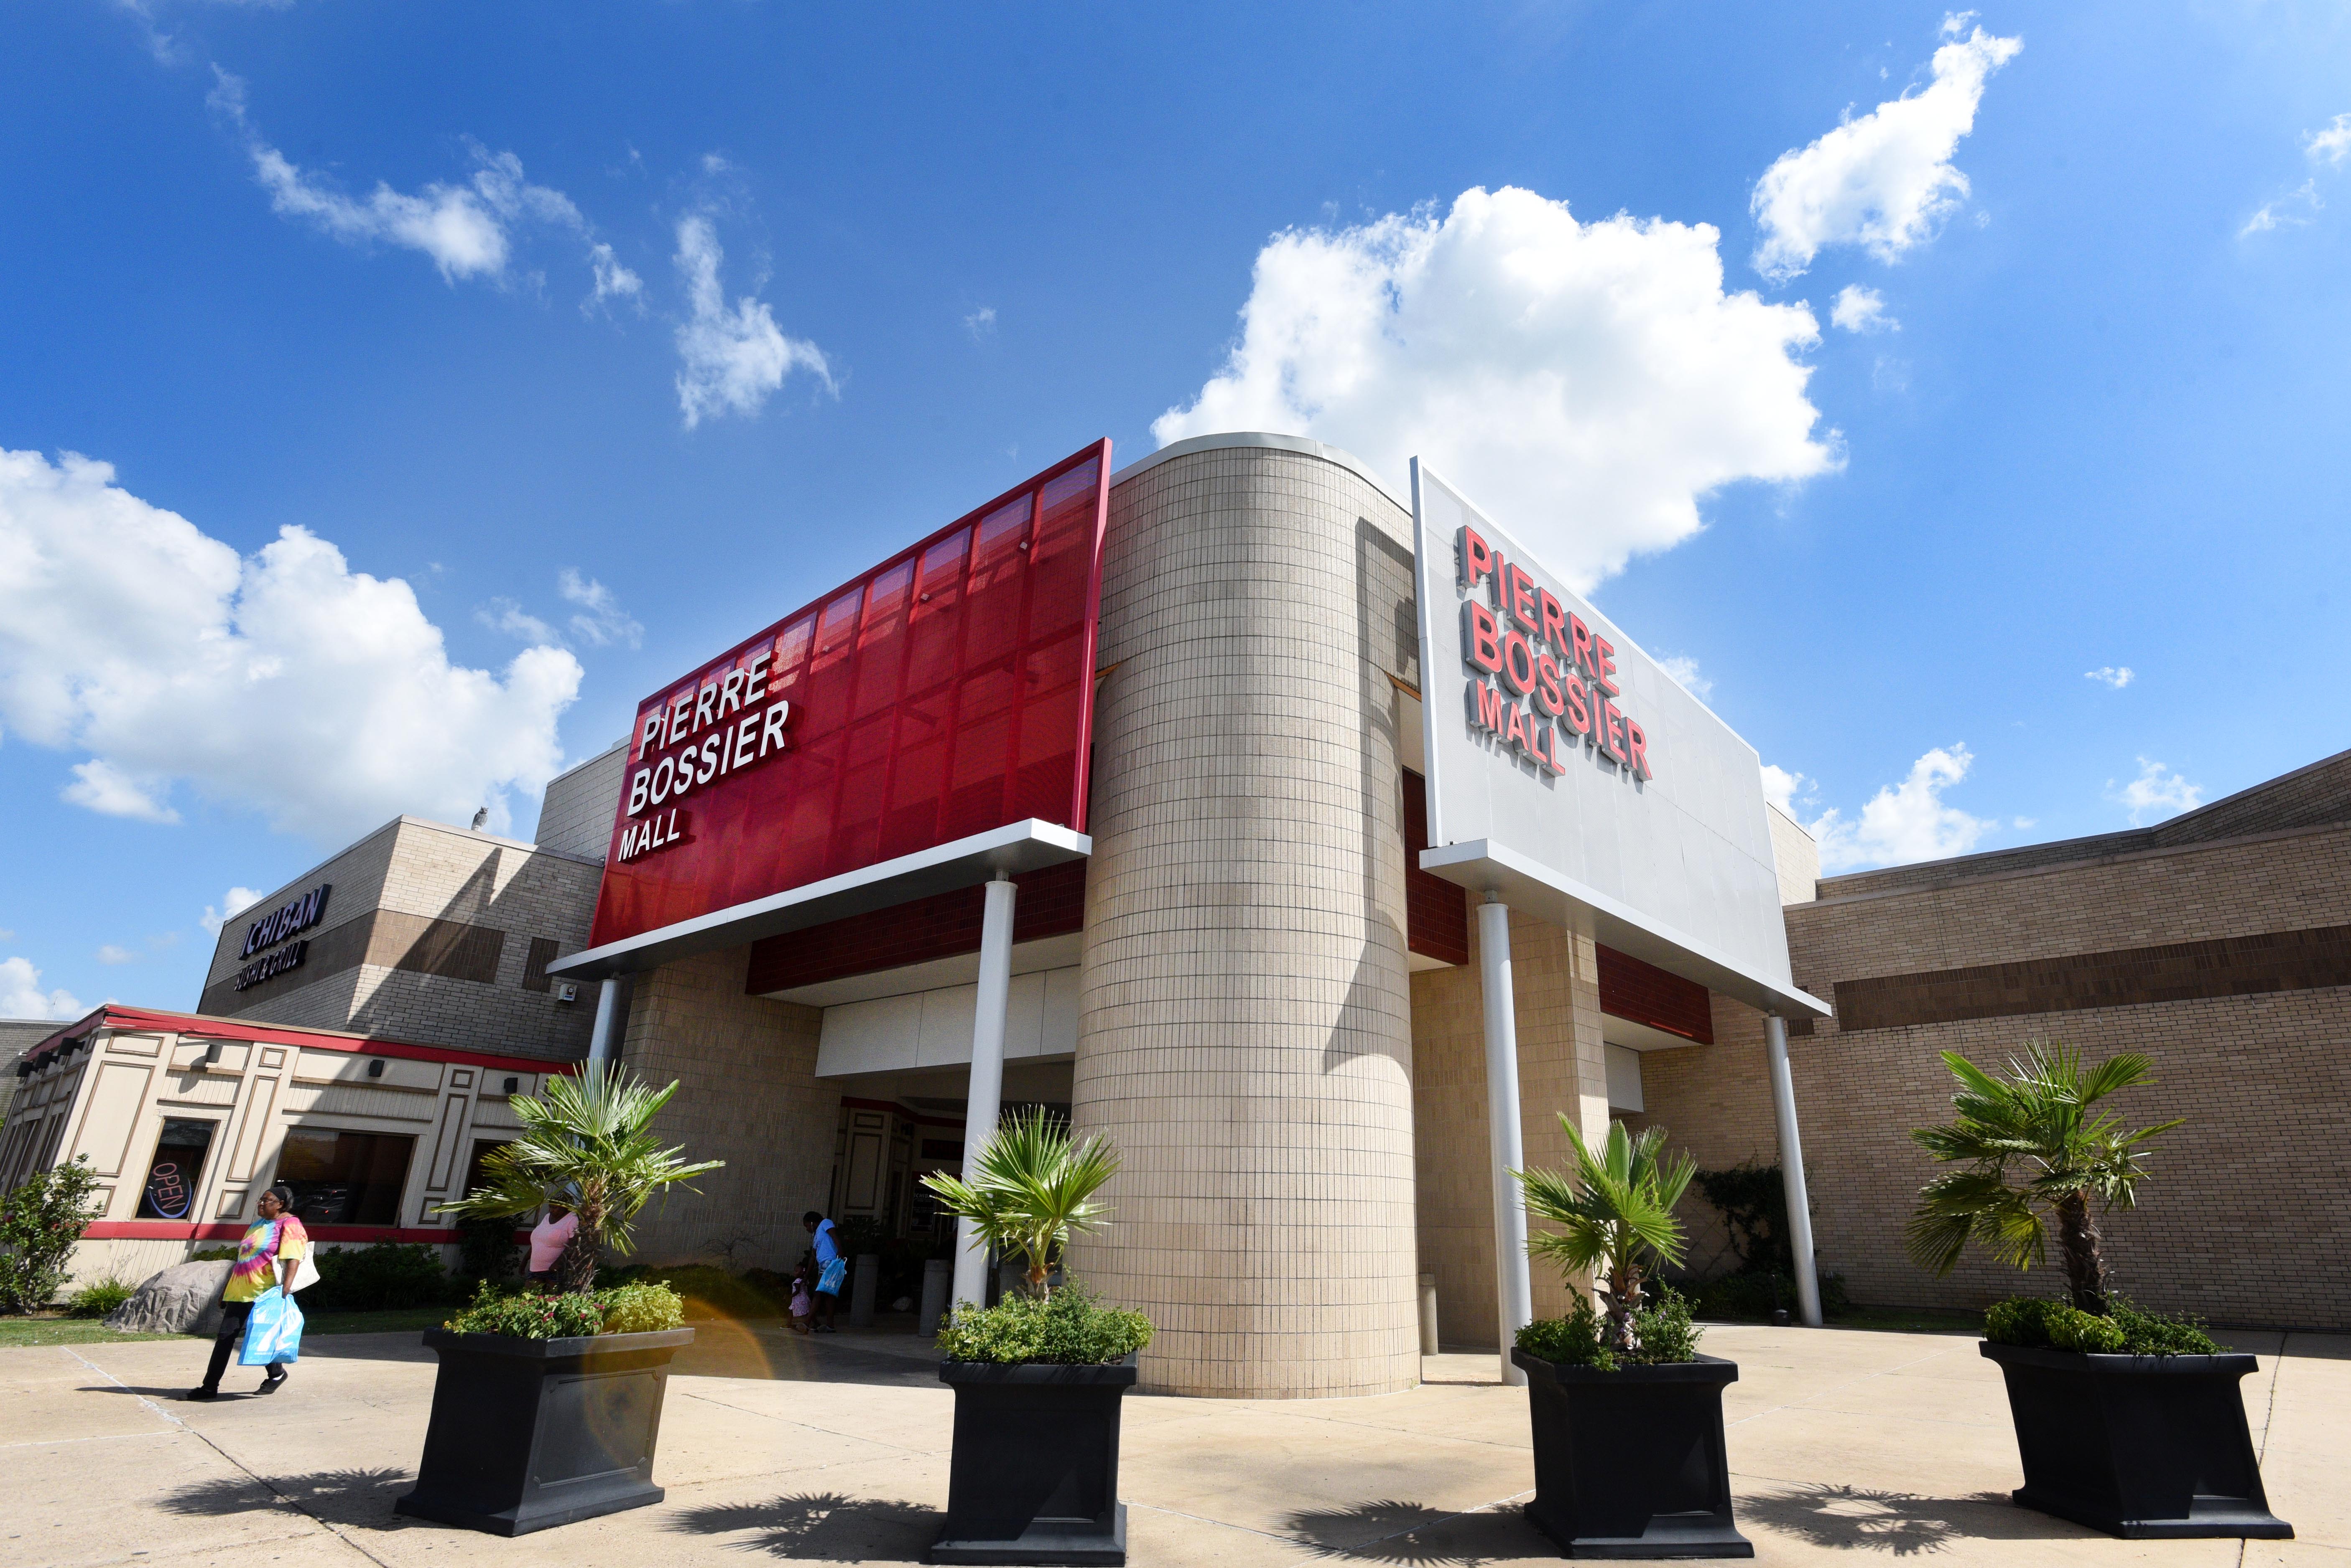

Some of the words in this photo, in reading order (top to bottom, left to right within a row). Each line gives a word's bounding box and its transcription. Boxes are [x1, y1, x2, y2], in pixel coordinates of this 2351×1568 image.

[1463, 525, 1619, 697] PIERRE
[638, 650, 773, 761] PIERRE
[1469, 599, 1652, 780] BOSSIER
[1474, 678, 1565, 776] MALL
[627, 700, 789, 817] BOSSIER
[618, 808, 680, 862] MALL
[234, 959, 263, 991] SUSHI
[260, 955, 270, 980] &
[270, 941, 302, 975] GRILL
[239, 883, 327, 960] ICHIBAN
[153, 1163, 186, 1209] OPEN
